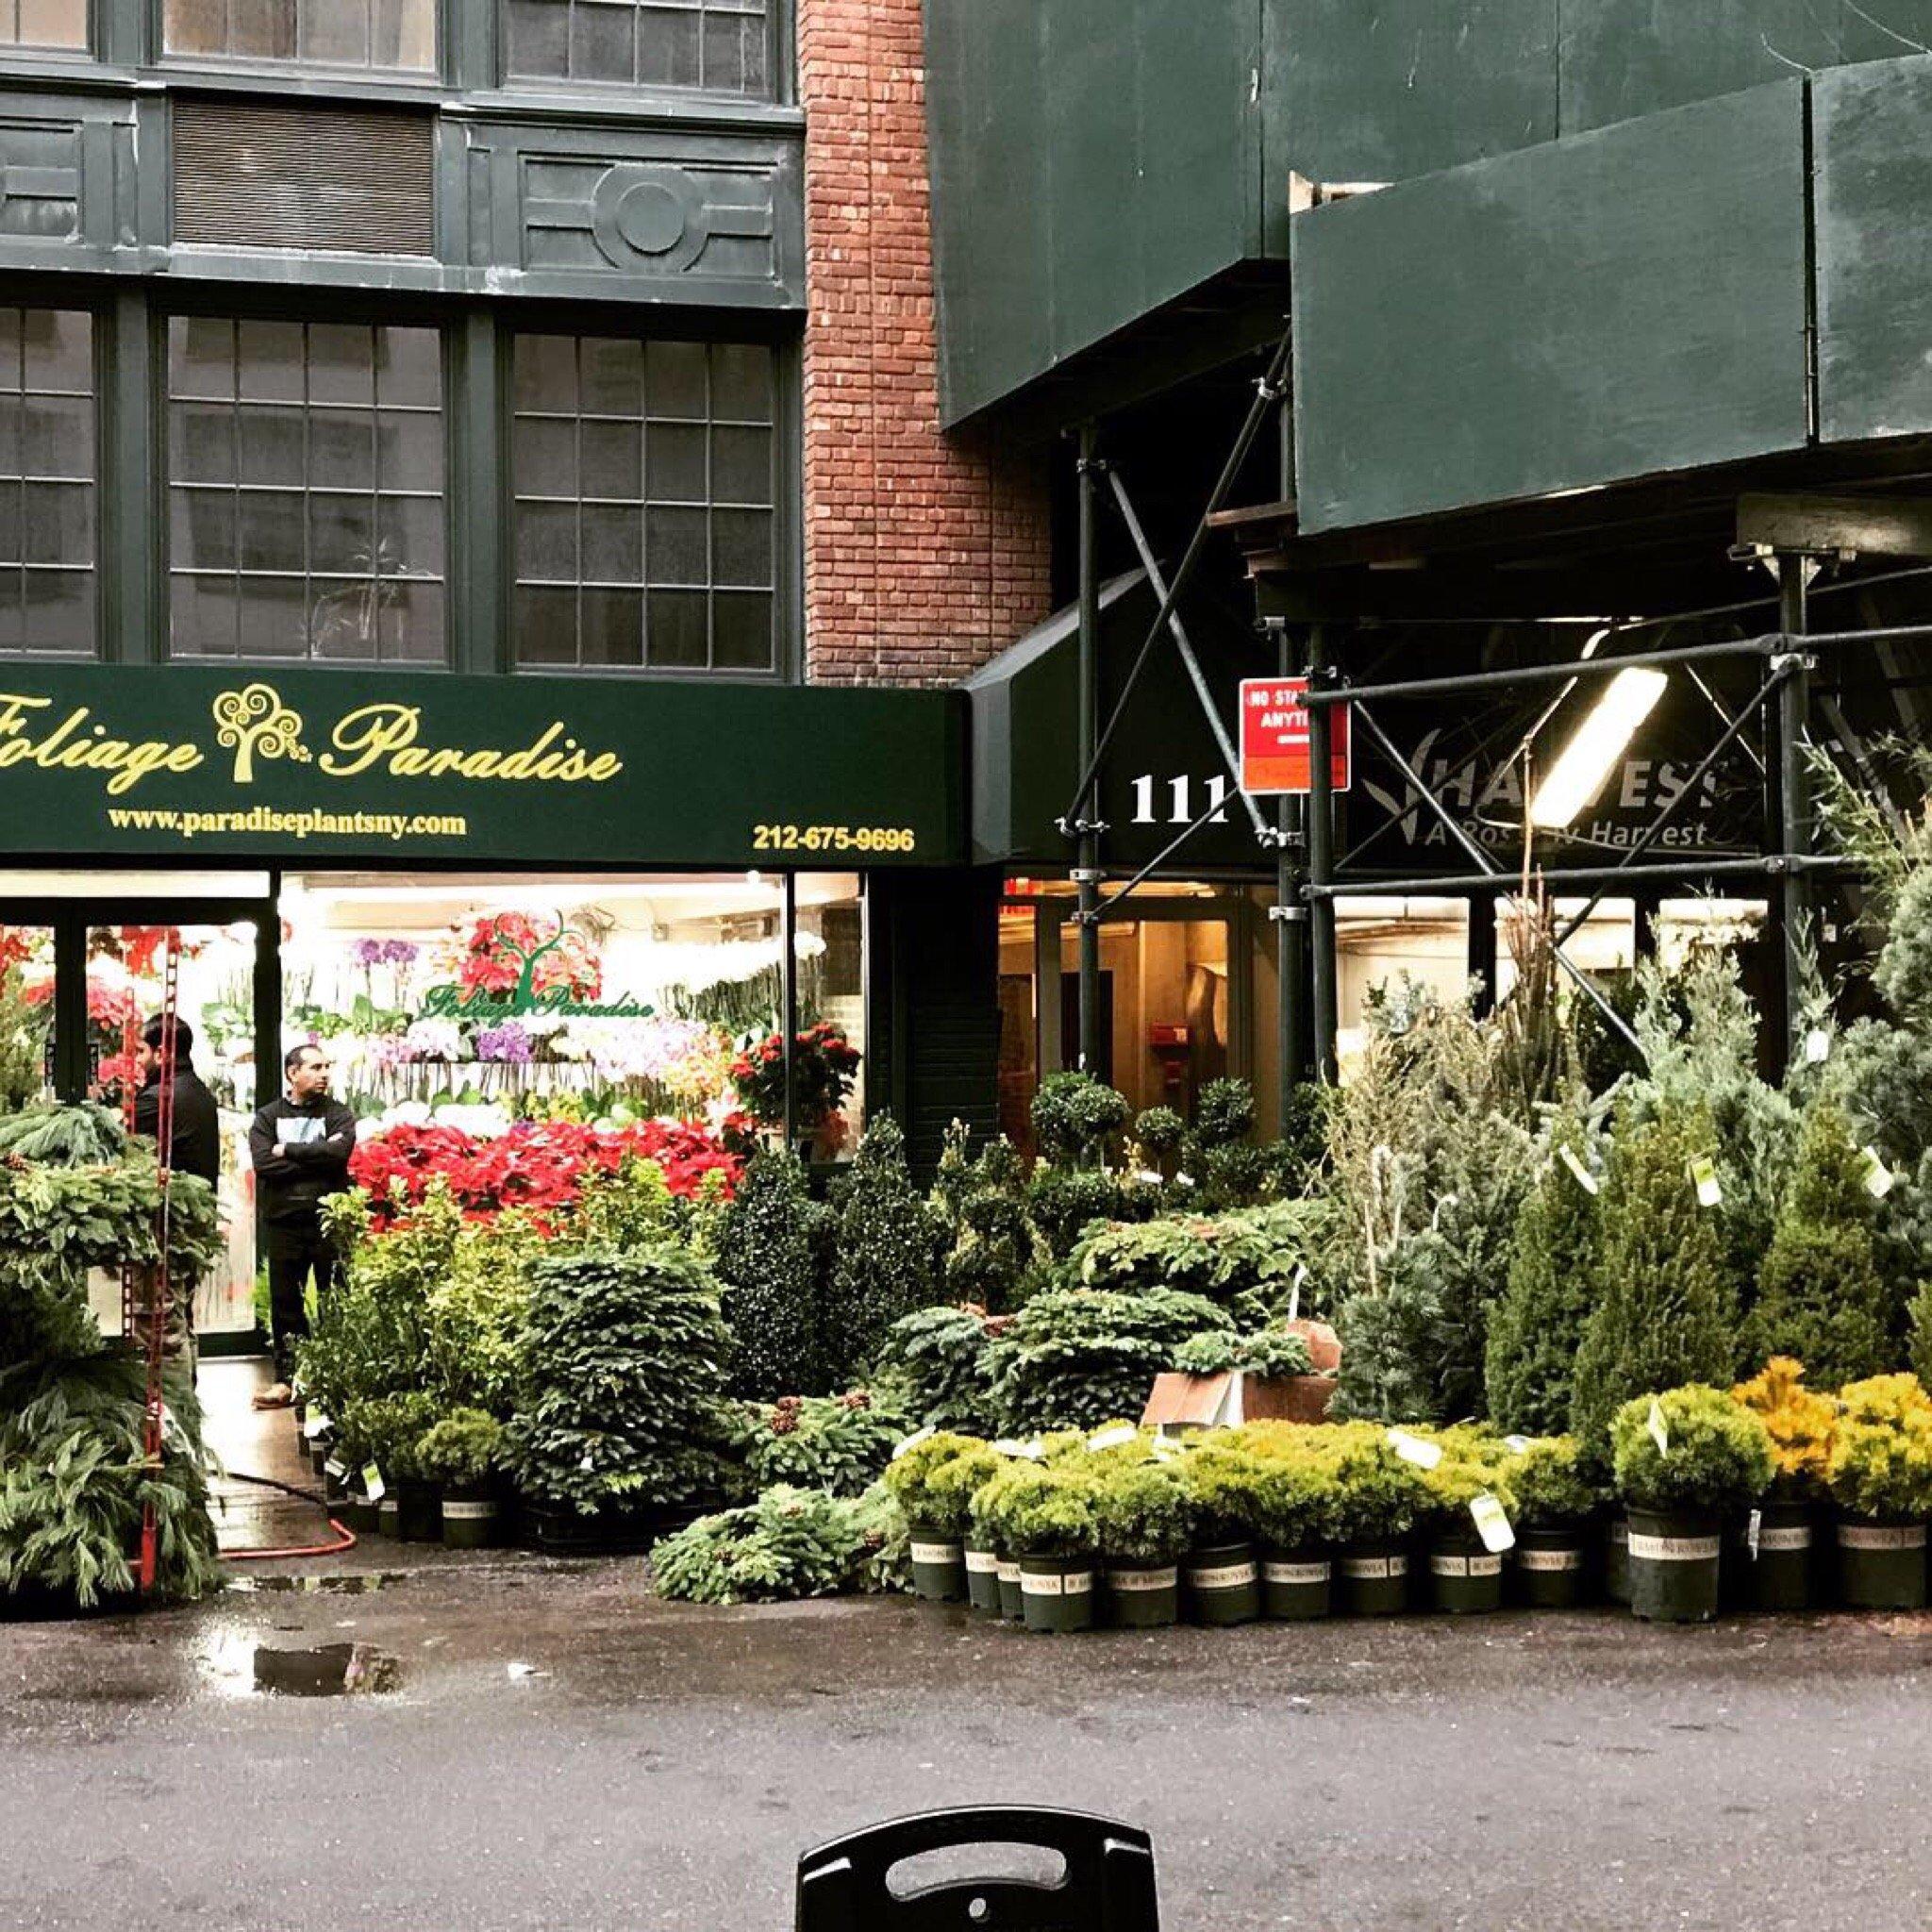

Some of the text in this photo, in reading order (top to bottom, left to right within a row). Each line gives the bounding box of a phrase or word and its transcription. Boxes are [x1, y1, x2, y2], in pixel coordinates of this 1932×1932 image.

[1249, 690, 1269, 707] NO
[1261, 710, 1309, 727] ANYTI
[321, 703, 623, 781] Paradise
[1131, 774, 1229, 823] 111
[108, 808, 466, 839] www.paradiseplantsny.com
[753, 824, 915, 851] 212-675-9696
[531, 984, 655, 1017] Paradise
